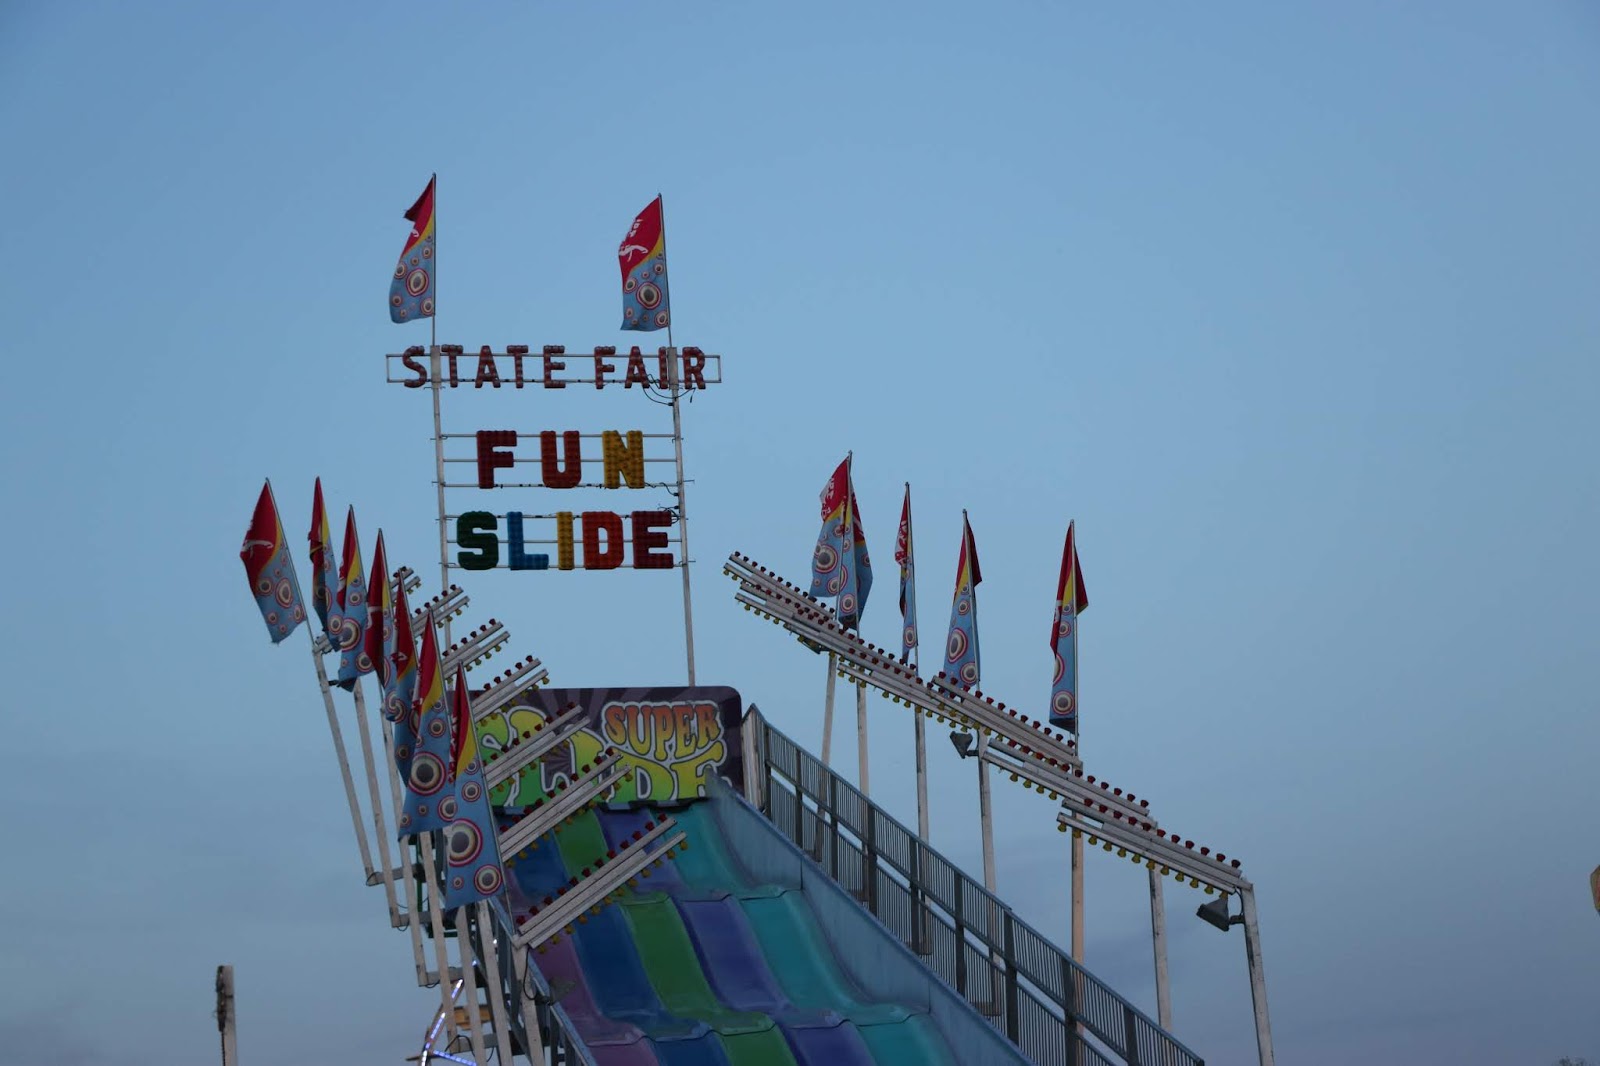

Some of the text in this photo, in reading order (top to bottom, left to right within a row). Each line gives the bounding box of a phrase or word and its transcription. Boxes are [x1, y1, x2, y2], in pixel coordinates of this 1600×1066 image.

[402, 344, 706, 389] STATE FAIR
[476, 430, 645, 489] FUN
[456, 510, 674, 570] SLIDE
[604, 703, 721, 762] SUPER
